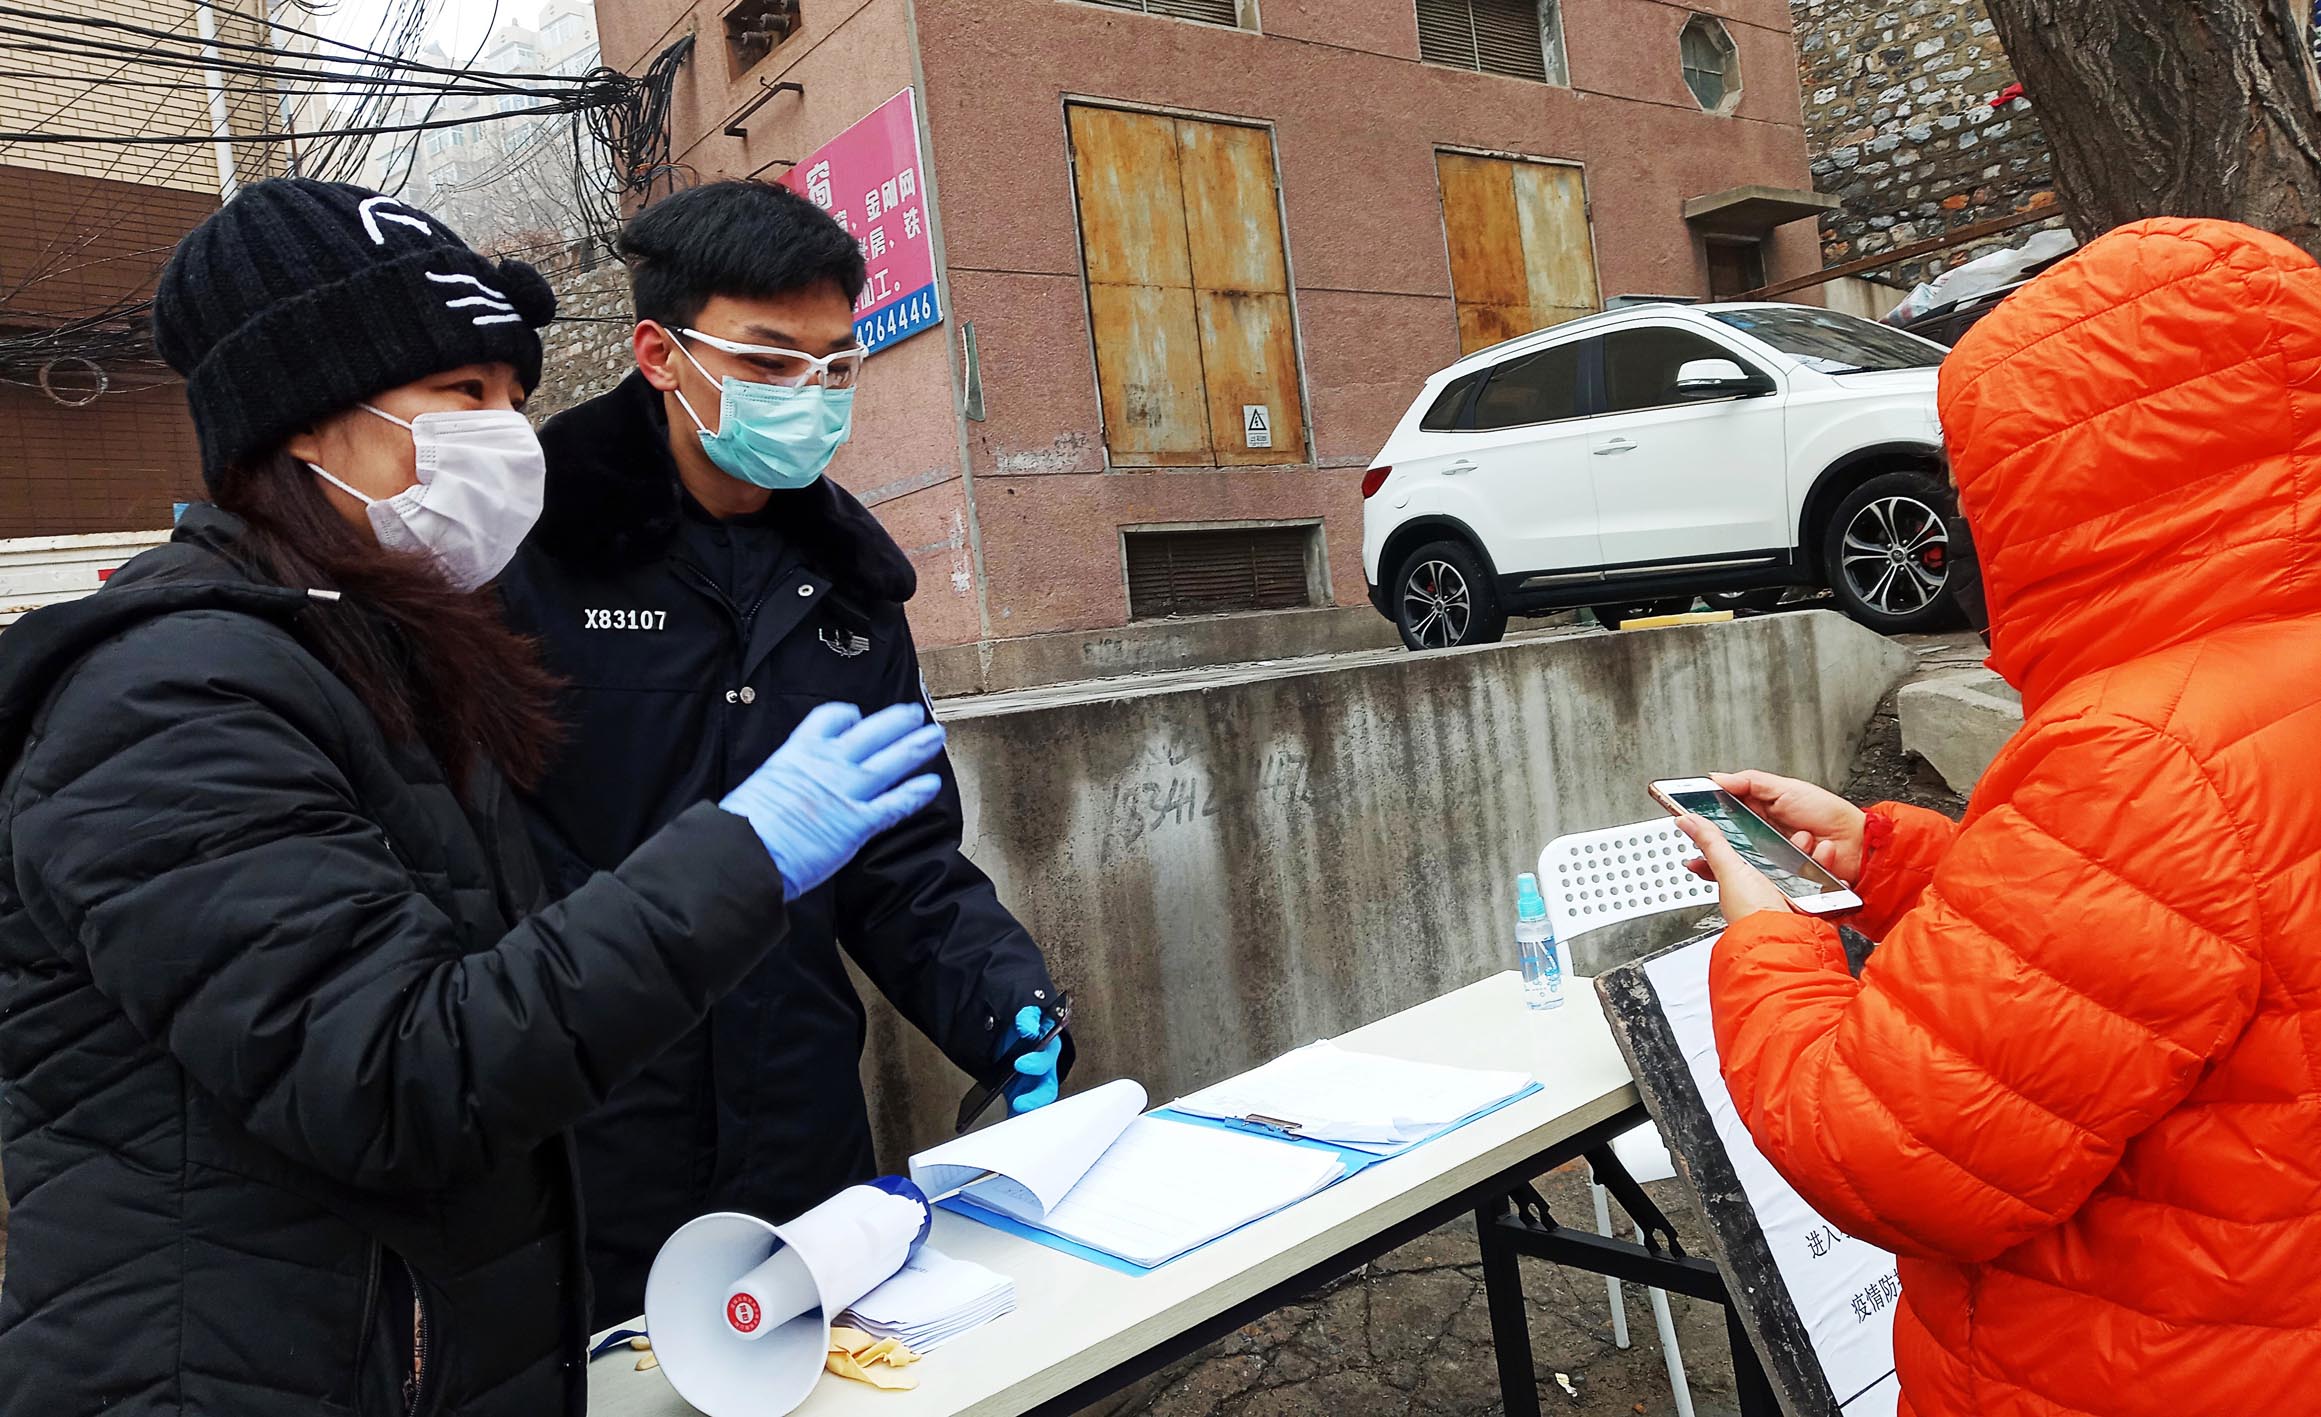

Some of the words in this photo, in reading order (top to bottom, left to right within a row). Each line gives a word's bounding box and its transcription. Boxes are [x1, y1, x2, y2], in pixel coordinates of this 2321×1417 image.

[854, 268, 901, 313] 加工。
[584, 608, 667, 630] X83107
[1805, 1225, 1850, 1259] 进入
